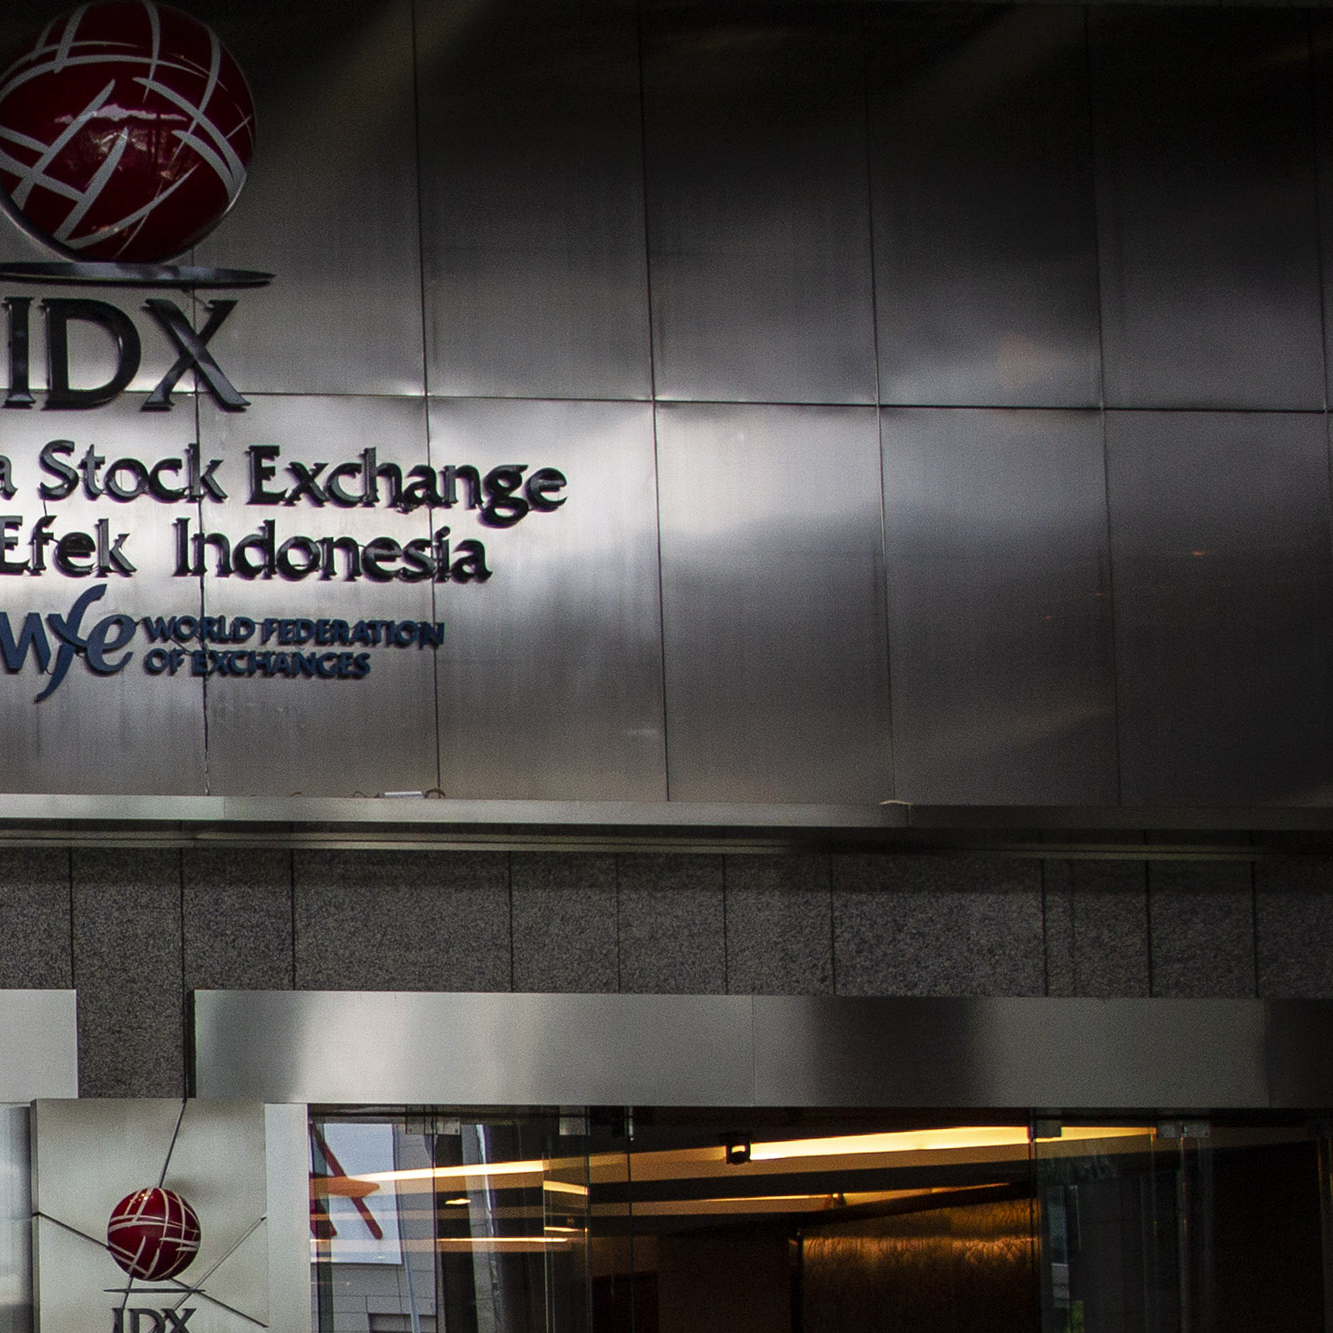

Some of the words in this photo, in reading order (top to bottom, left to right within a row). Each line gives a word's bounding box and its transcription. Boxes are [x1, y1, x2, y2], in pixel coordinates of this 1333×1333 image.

[2, 295, 250, 412] IDX
[38, 441, 228, 504] Stock
[247, 447, 567, 528] Exchange
[172, 519, 492, 584] Indonesia
[142, 616, 255, 644] WORLD
[263, 616, 445, 648] FEDERATION
[144, 649, 184, 675] OF
[185, 649, 371, 678] EXCHANGES
